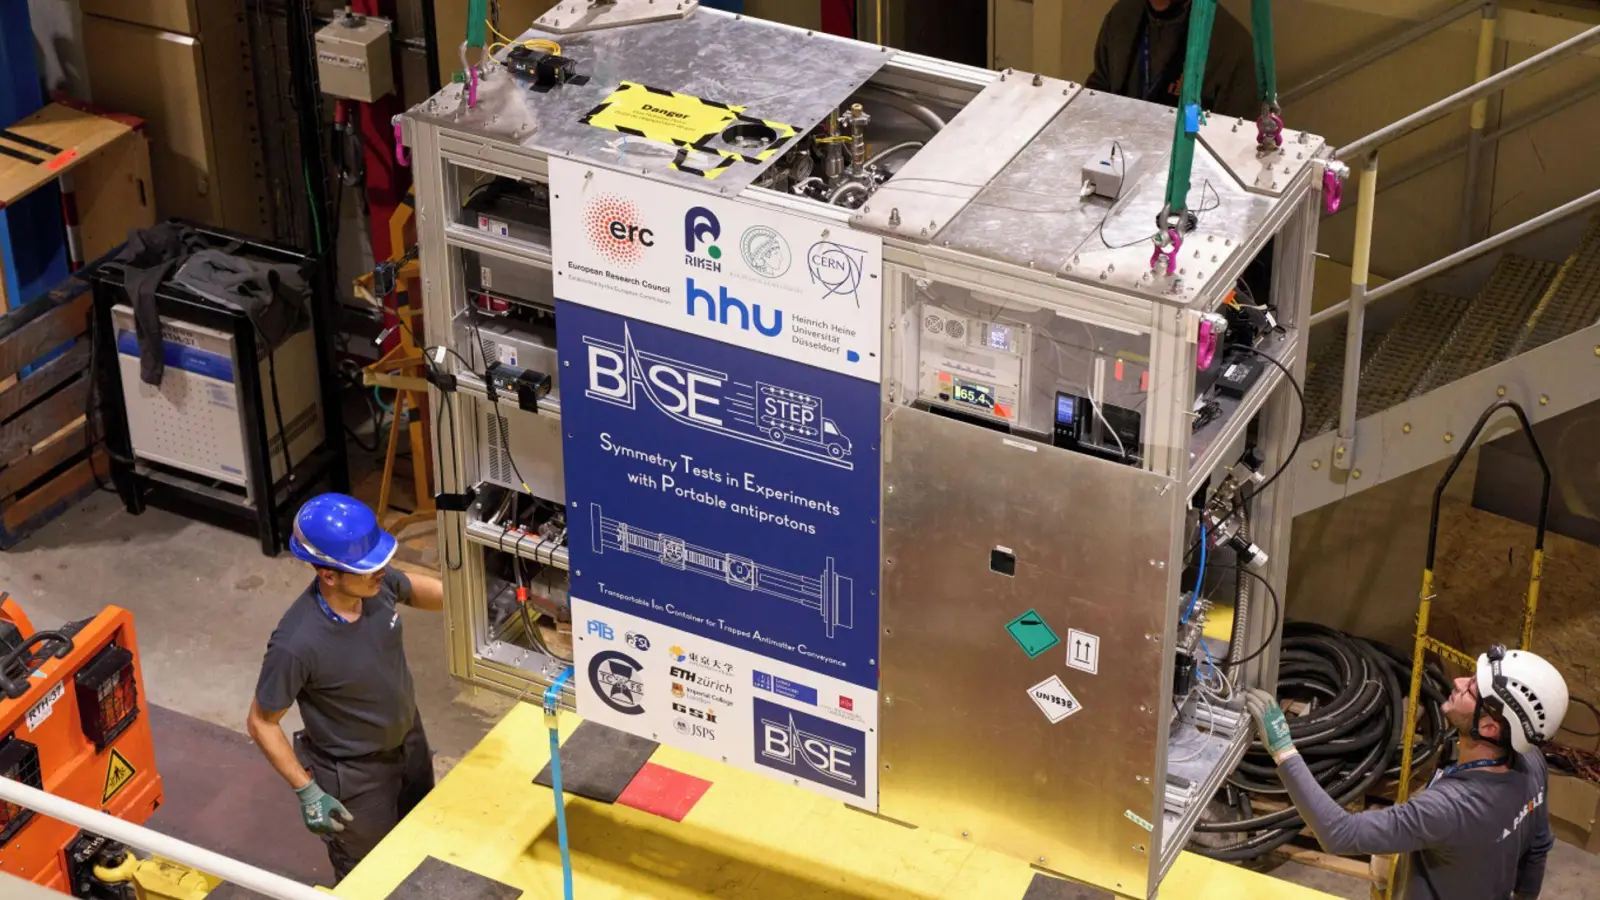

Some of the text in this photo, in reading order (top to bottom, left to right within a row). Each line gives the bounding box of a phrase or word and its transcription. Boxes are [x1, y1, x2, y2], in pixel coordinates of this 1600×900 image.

[641, 104, 690, 119] Danger
[609, 220, 654, 247] erc
[685, 254, 721, 273] RIKEN
[811, 254, 845, 271] CERN
[568, 261, 670, 294] European Research Council
[686, 277, 783, 338] hhu
[792, 314, 857, 337] Heinrich Heine
[792, 325, 840, 344] Universität
[792, 335, 840, 354] Düsseldorf
[588, 321, 723, 427] BASE
[764, 397, 815, 425] STEP
[600, 432, 840, 516] Symmetry Tests in Experiments
[627, 472, 816, 535] with Portable antiprotons
[587, 620, 614, 641] PTB
[598, 582, 846, 667] Transportable Ion Container for Trapped Antimatter Conveyance
[688, 652, 734, 672] 東京大学
[669, 666, 696, 682] ETH
[696, 674, 733, 694] zürich
[691, 724, 715, 740] JSPS
[765, 711, 853, 780] BASE
